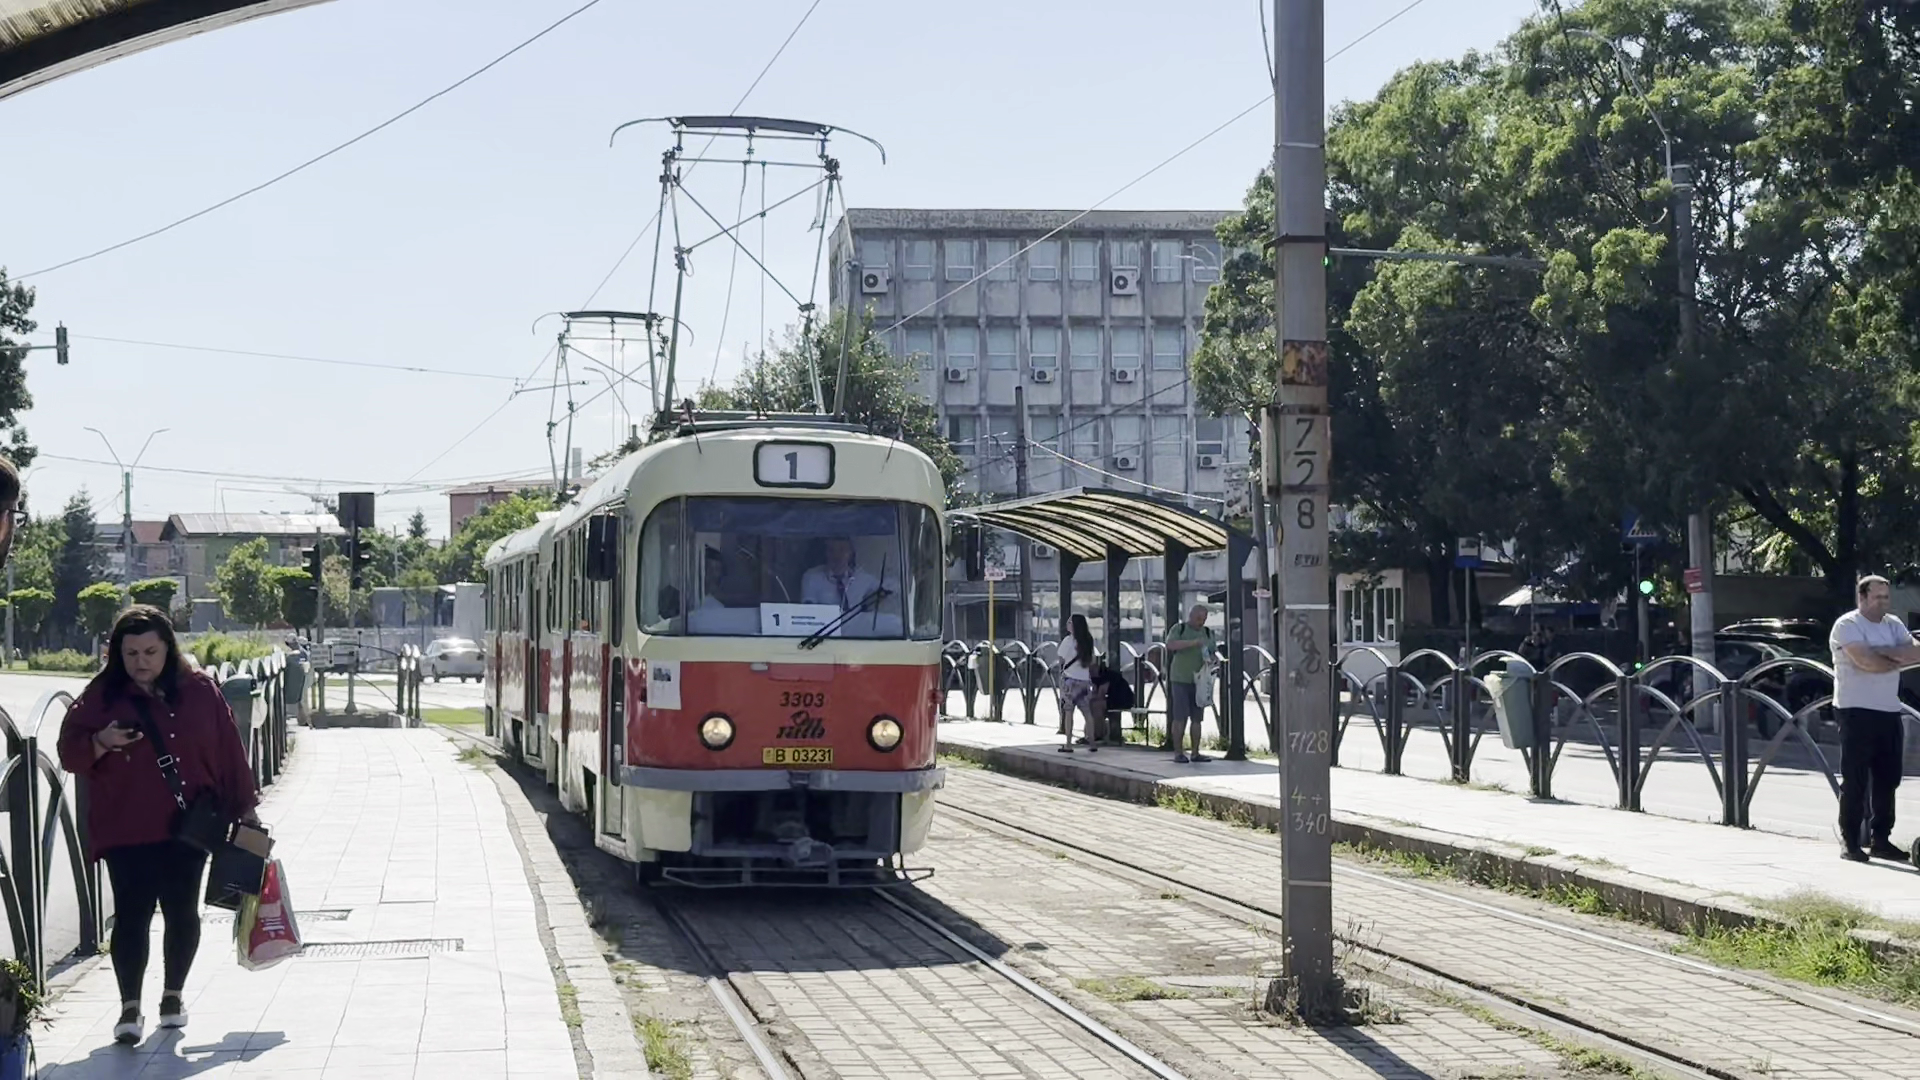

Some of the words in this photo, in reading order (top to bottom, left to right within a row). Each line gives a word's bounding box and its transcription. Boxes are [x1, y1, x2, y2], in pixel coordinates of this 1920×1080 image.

[1296, 418, 1314, 448] 7
[784, 452, 798, 480] 1
[1297, 498, 1315, 529] 8
[772, 613, 780, 627] 1
[779, 691, 825, 708] 3303
[775, 749, 786, 762] B
[792, 748, 832, 762] 03231
